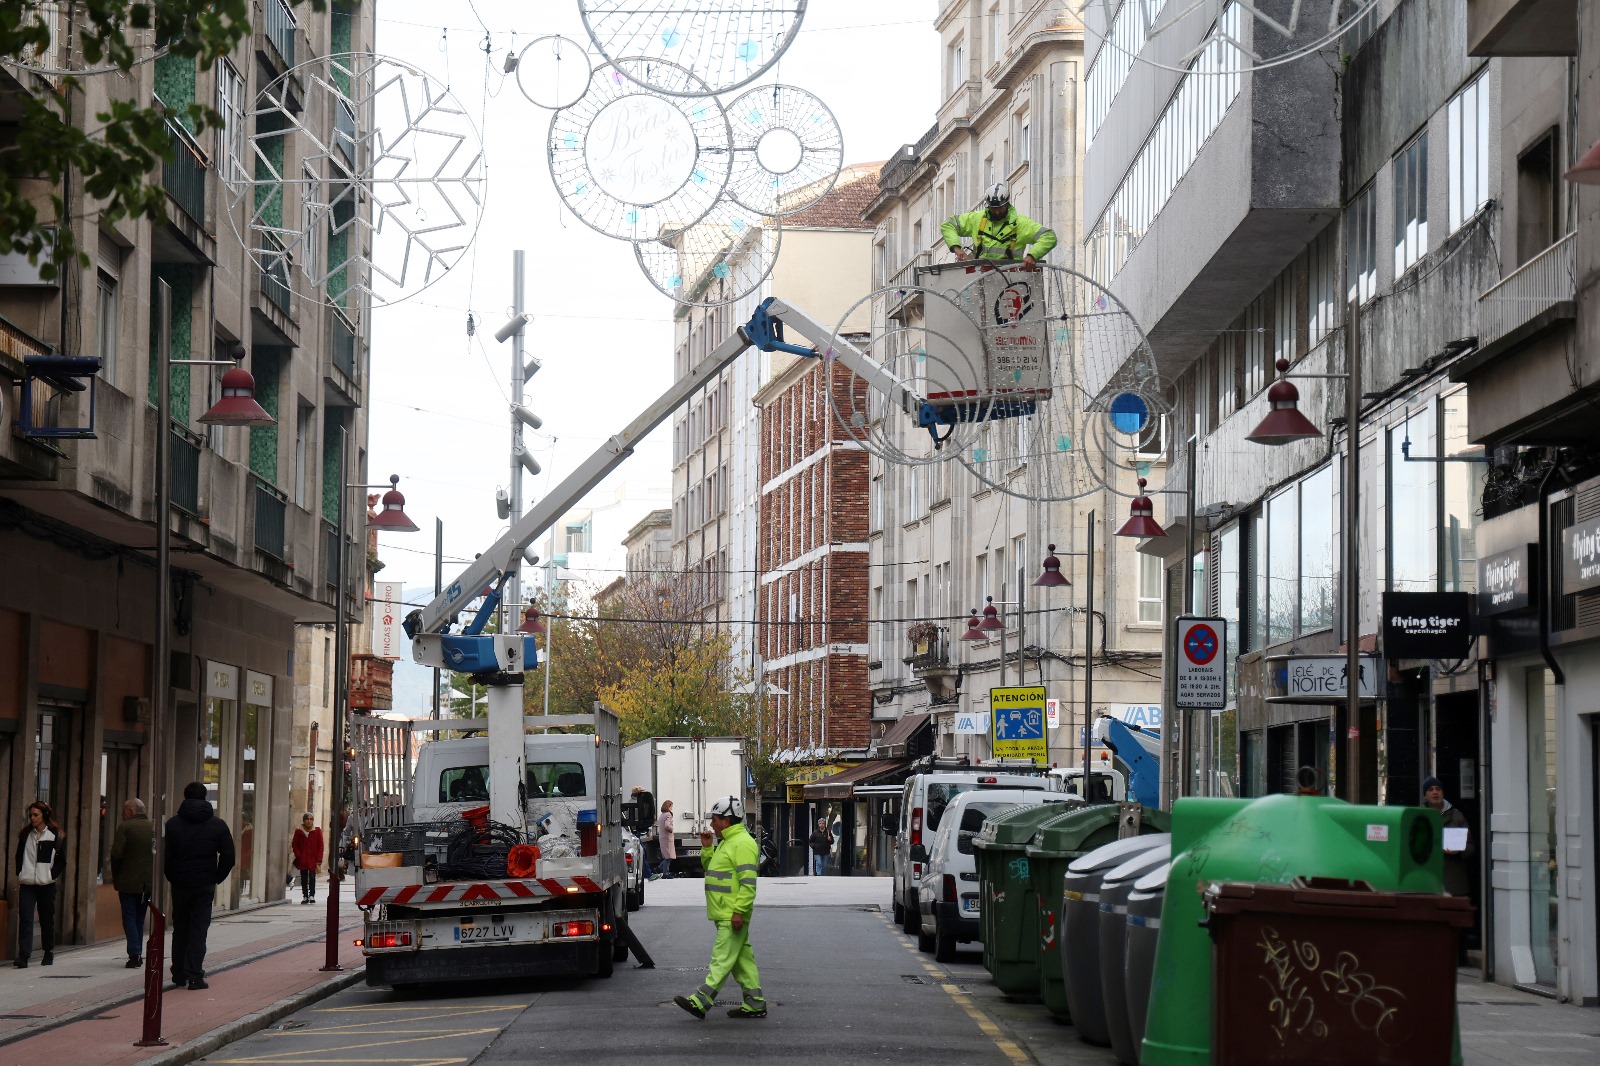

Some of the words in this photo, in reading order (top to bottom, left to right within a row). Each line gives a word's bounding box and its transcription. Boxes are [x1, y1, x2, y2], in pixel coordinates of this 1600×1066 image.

[1486, 561, 1504, 592] flying
[1504, 557, 1520, 586] tiger
[1391, 616, 1427, 628] flying
[1428, 616, 1461, 628] tiger
[383, 627, 391, 656] FINCAS
[1292, 664, 1314, 677] LELÉ
[1322, 667, 1335, 676] DE
[1292, 677, 1338, 692] NOITE
[993, 692, 1044, 703] ATENCIÓN
[461, 927, 490, 939] 6727
[493, 926, 515, 937] LVV
